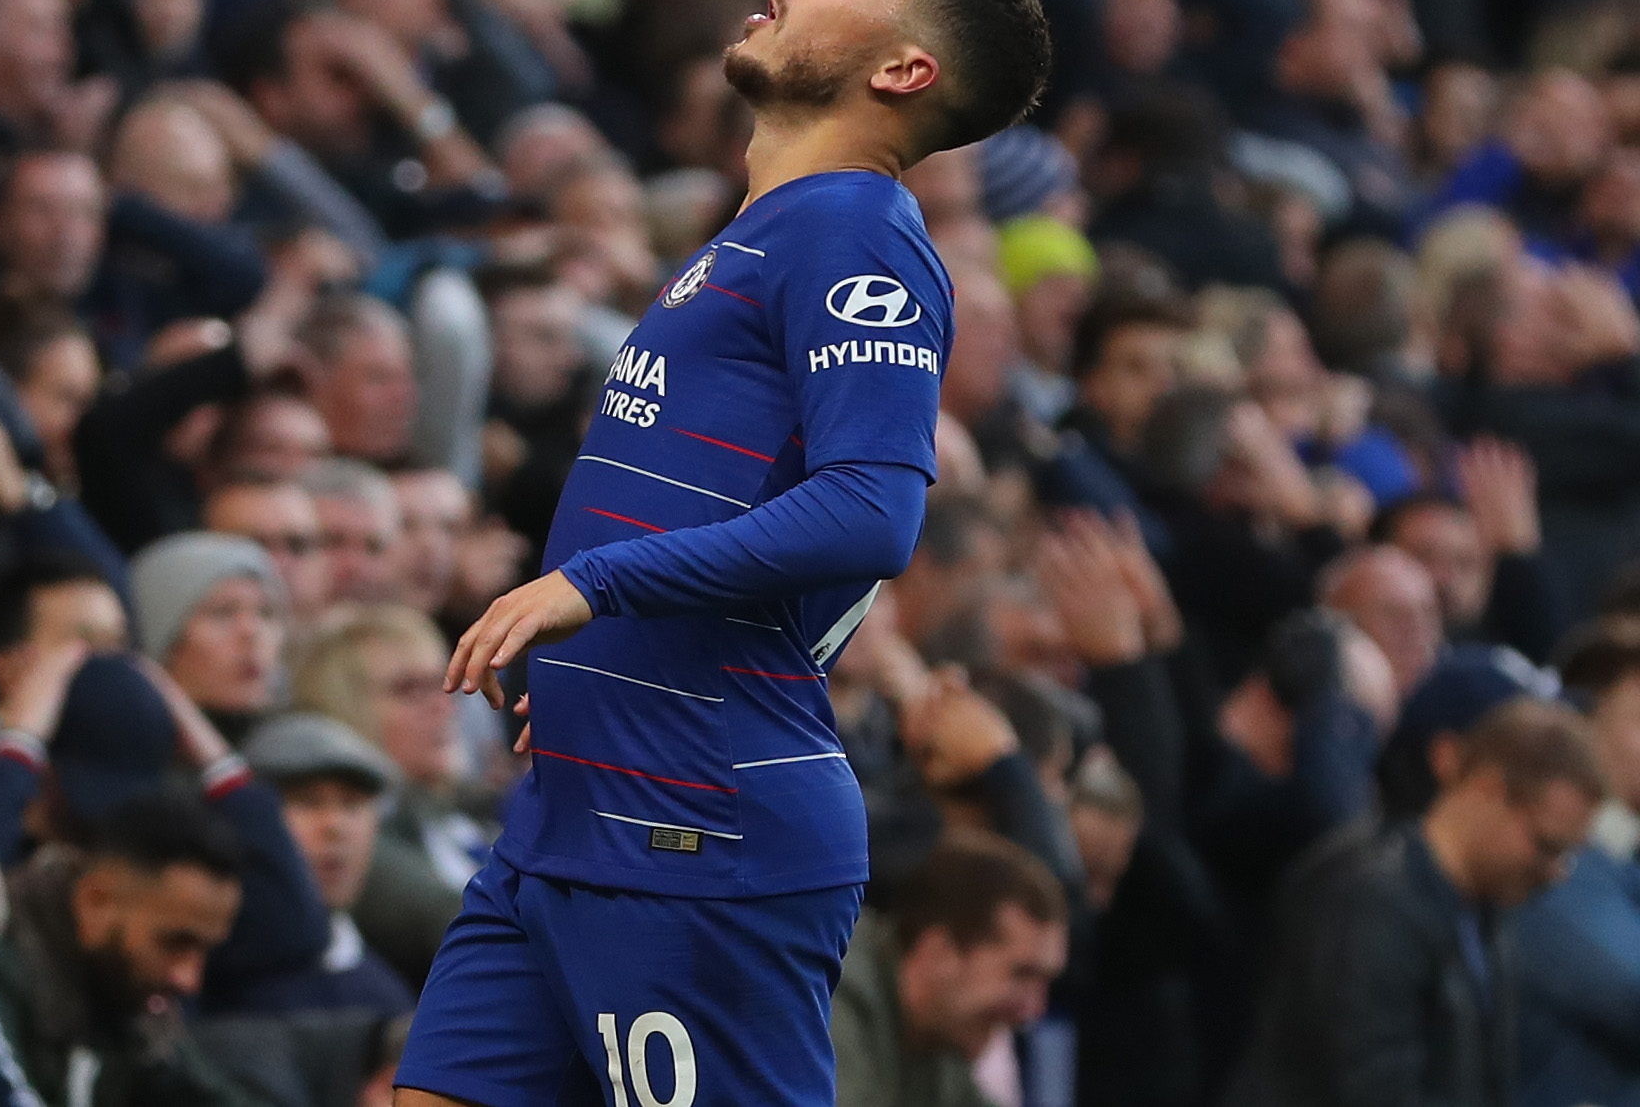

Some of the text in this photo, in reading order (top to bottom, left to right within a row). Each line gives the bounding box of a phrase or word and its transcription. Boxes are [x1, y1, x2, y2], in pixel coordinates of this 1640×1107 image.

[604, 345, 666, 397] AMA
[808, 340, 938, 375] HYUNDAI
[601, 389, 661, 428] TYRES
[597, 1011, 697, 1107] 10
